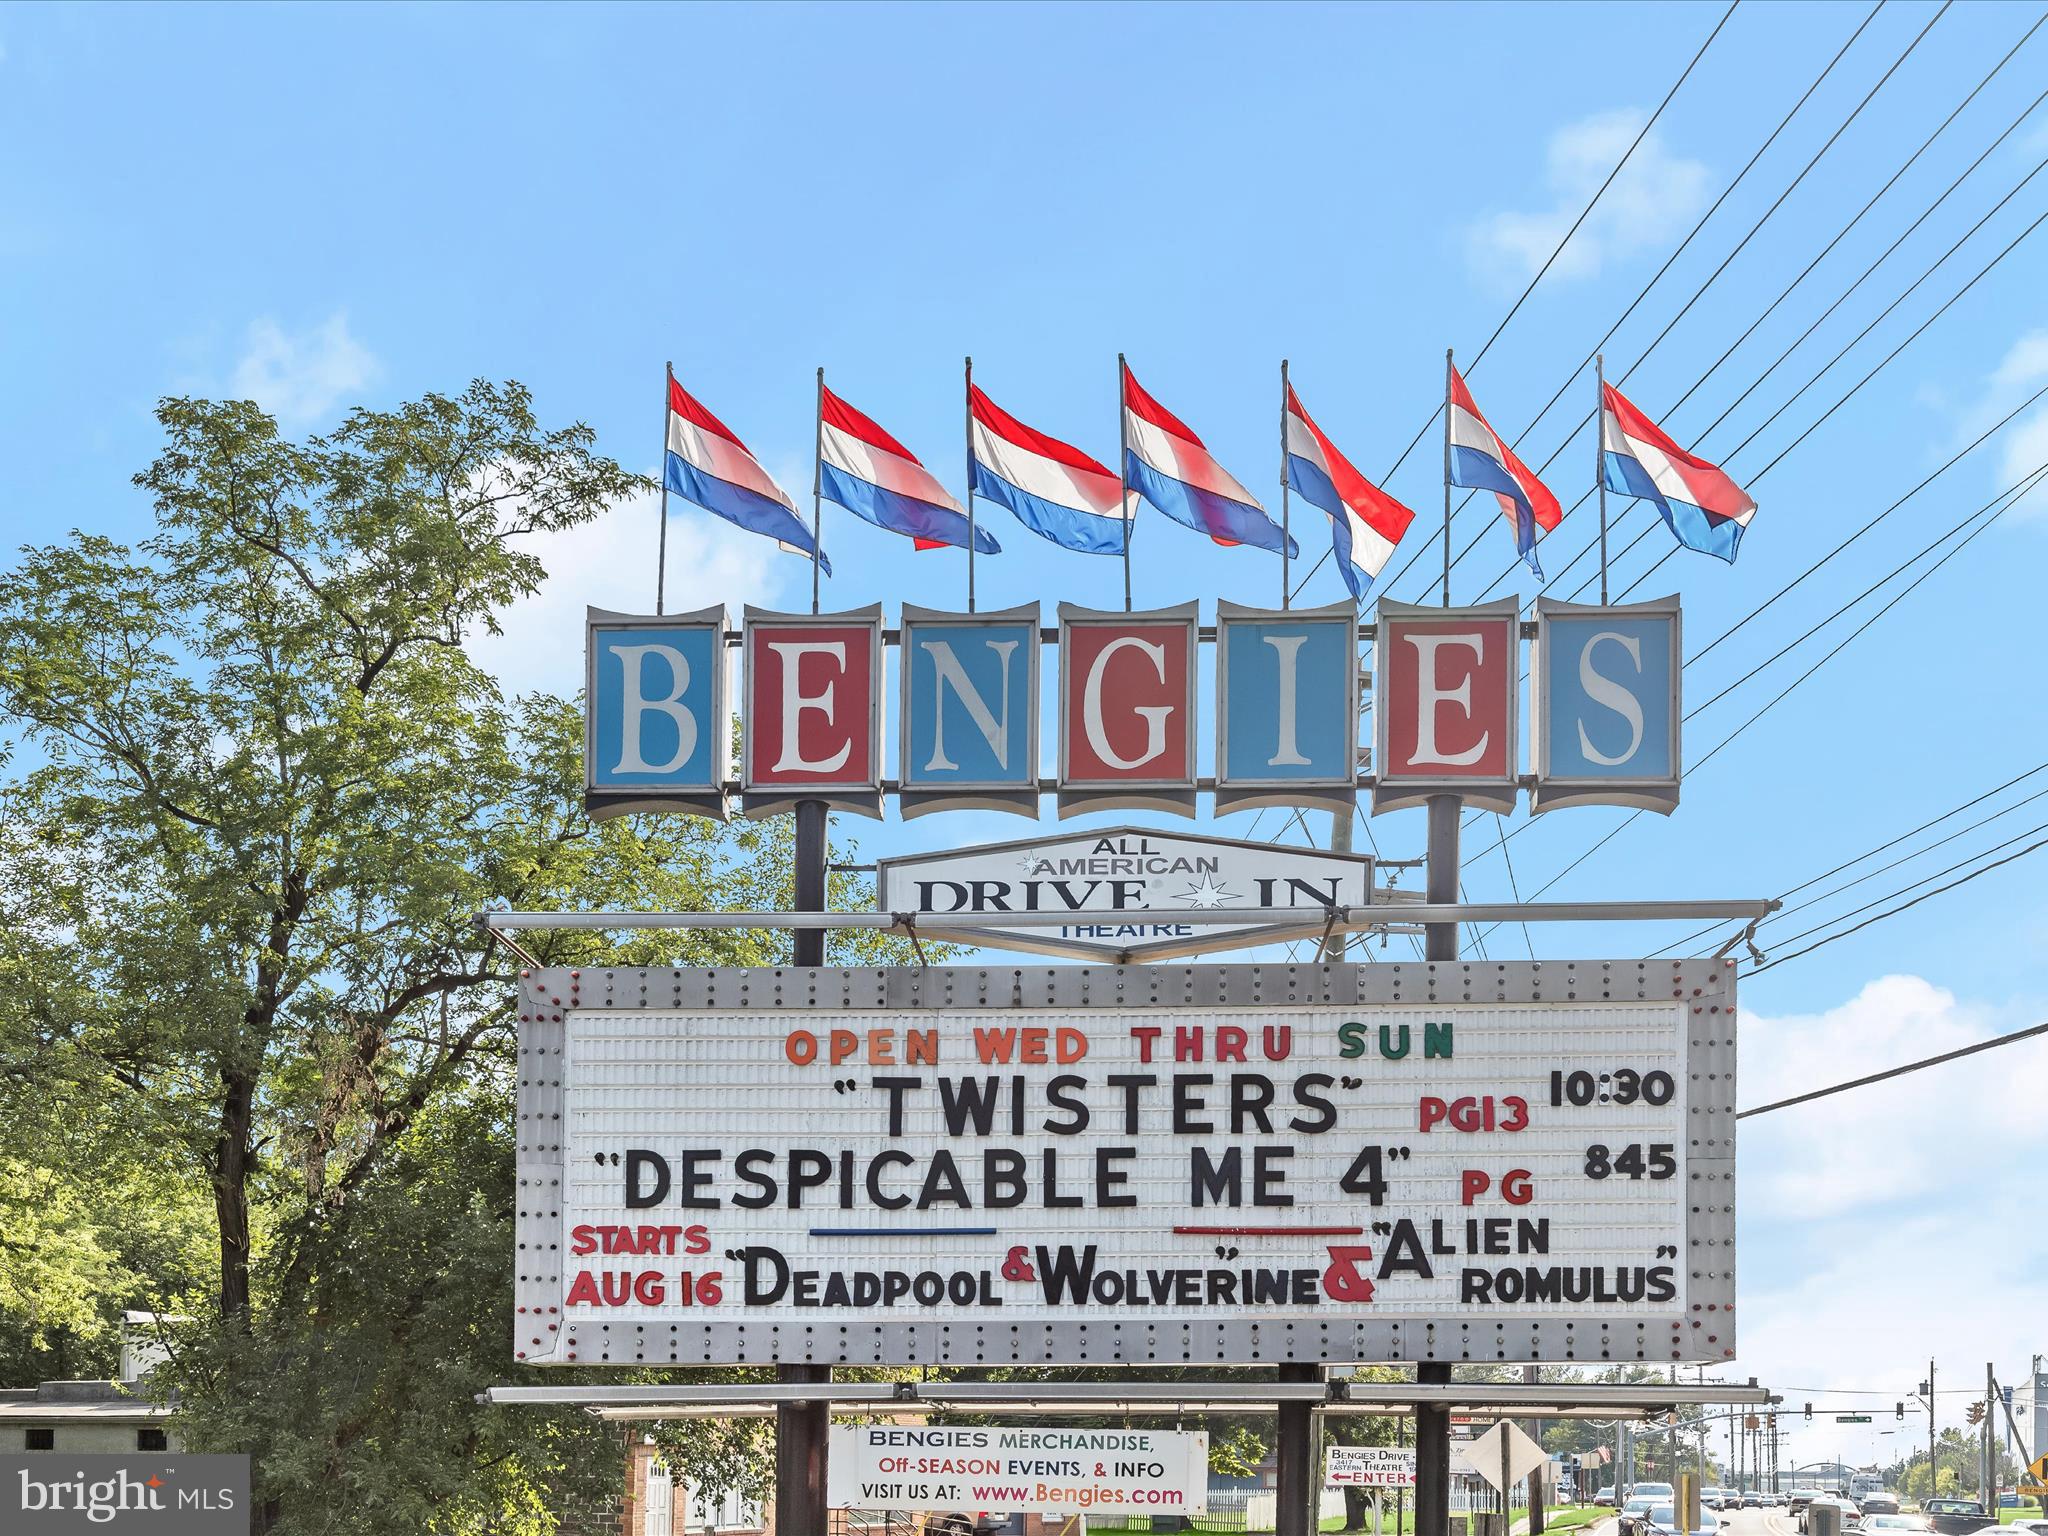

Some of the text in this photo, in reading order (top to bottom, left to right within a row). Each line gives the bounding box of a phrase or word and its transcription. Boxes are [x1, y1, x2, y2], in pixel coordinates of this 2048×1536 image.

[607, 631, 1645, 775] BENGIES
[1092, 838, 1160, 855] ALL
[1035, 856, 1219, 876] AMERICAN
[914, 877, 1343, 911] DRIVE IN
[1059, 923, 1193, 938] THEATRE
[785, 1022, 1453, 1066] OPEN WED THRU SUN
[1551, 1068, 1675, 1107] 10:30
[1191, 1146, 1295, 1208] ME
[1584, 1143, 1677, 1181] 845
[1462, 1169, 1534, 1206] PG
[571, 1225, 711, 1255] STARTS
[566, 1270, 723, 1306] AUG 16
[1001, 1246, 1037, 1283] &
[1323, 1245, 1376, 1303] &
[869, 1431, 1155, 1452] BENGIES MERCHANDISE,
[878, 1457, 1165, 1478] Off-SEASON EVENTS, & INFO
[1353, 1473, 1406, 1484] ENTER
[1362, 1460, 1403, 1472] THEATRE
[861, 1483, 1183, 1507] VISIT US AT: www.Bengies.com
